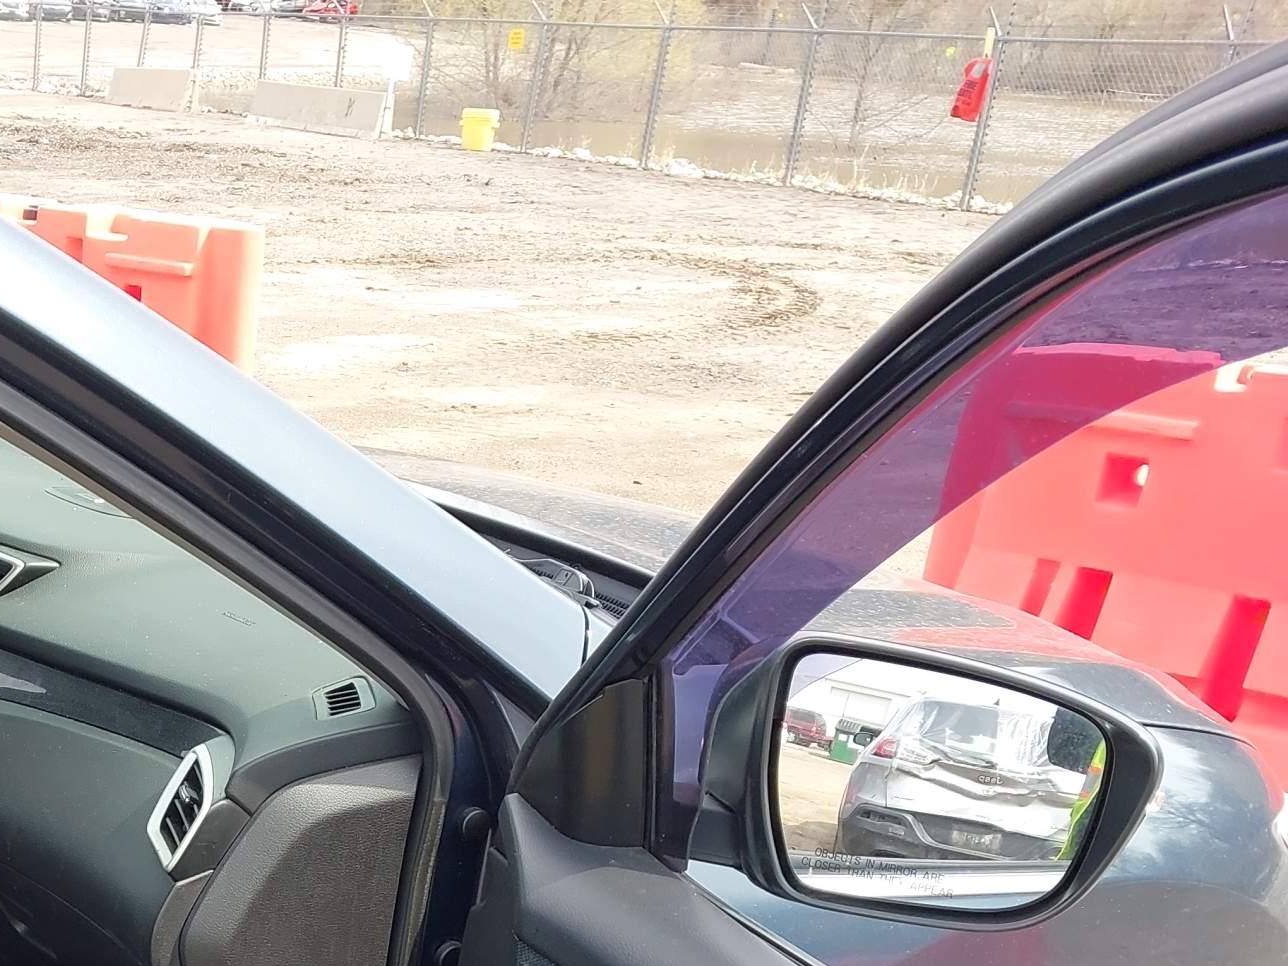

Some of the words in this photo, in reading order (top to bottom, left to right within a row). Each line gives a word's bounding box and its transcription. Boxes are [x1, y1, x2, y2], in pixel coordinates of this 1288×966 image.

[801, 856, 841, 874] CLOSER
[847, 865, 873, 880] THAN
[814, 847, 862, 866] OBJECTS
[866, 858, 876, 869] IN
[879, 861, 918, 878] MIRROR
